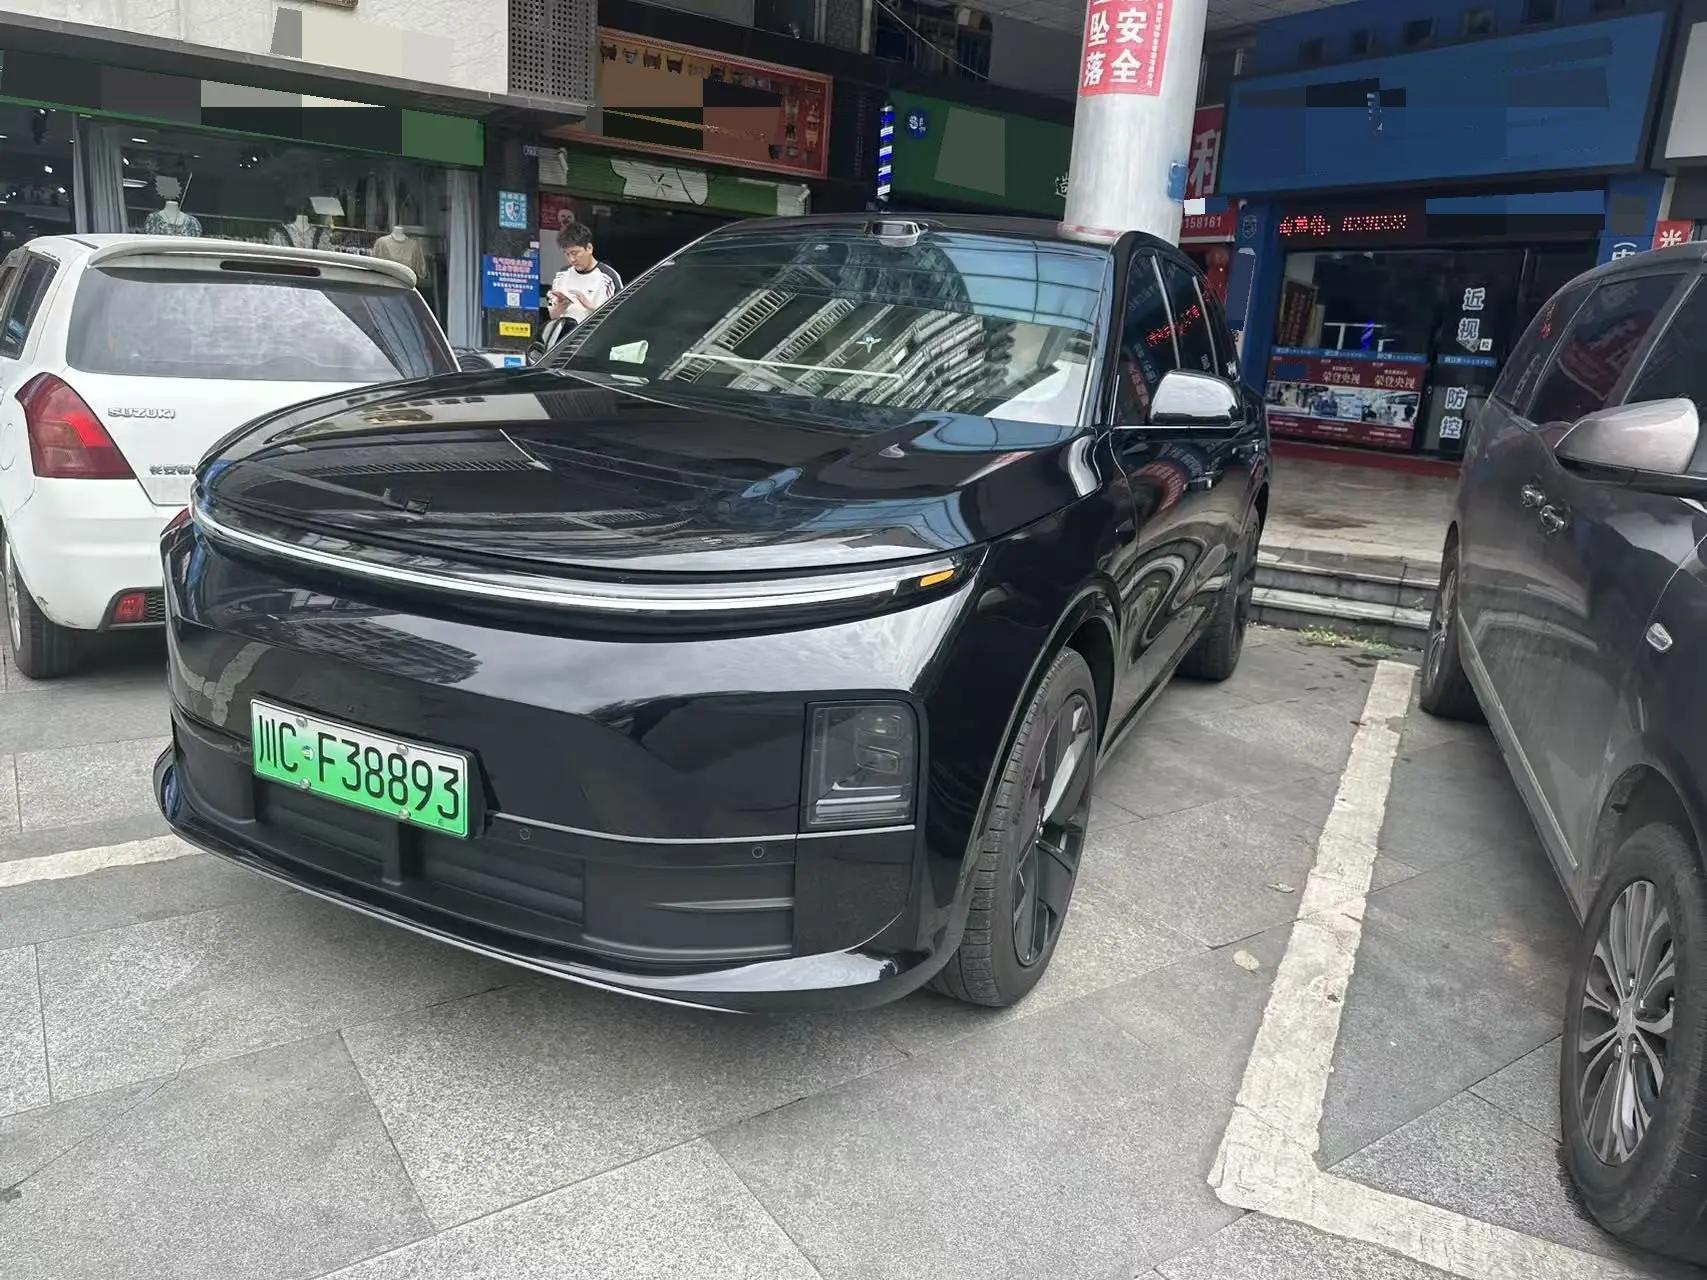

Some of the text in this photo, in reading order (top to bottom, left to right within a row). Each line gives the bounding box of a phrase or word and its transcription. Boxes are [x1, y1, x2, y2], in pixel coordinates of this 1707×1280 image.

[1083, 0, 1111, 87] 坠落
[1109, 0, 1148, 83] 安全
[1190, 128, 1222, 198] 利
[107, 407, 176, 420] SUZUKI
[1321, 371, 1361, 386] 荣登央视
[1373, 374, 1417, 390] 荣登央视
[317, 731, 460, 820] F38893
